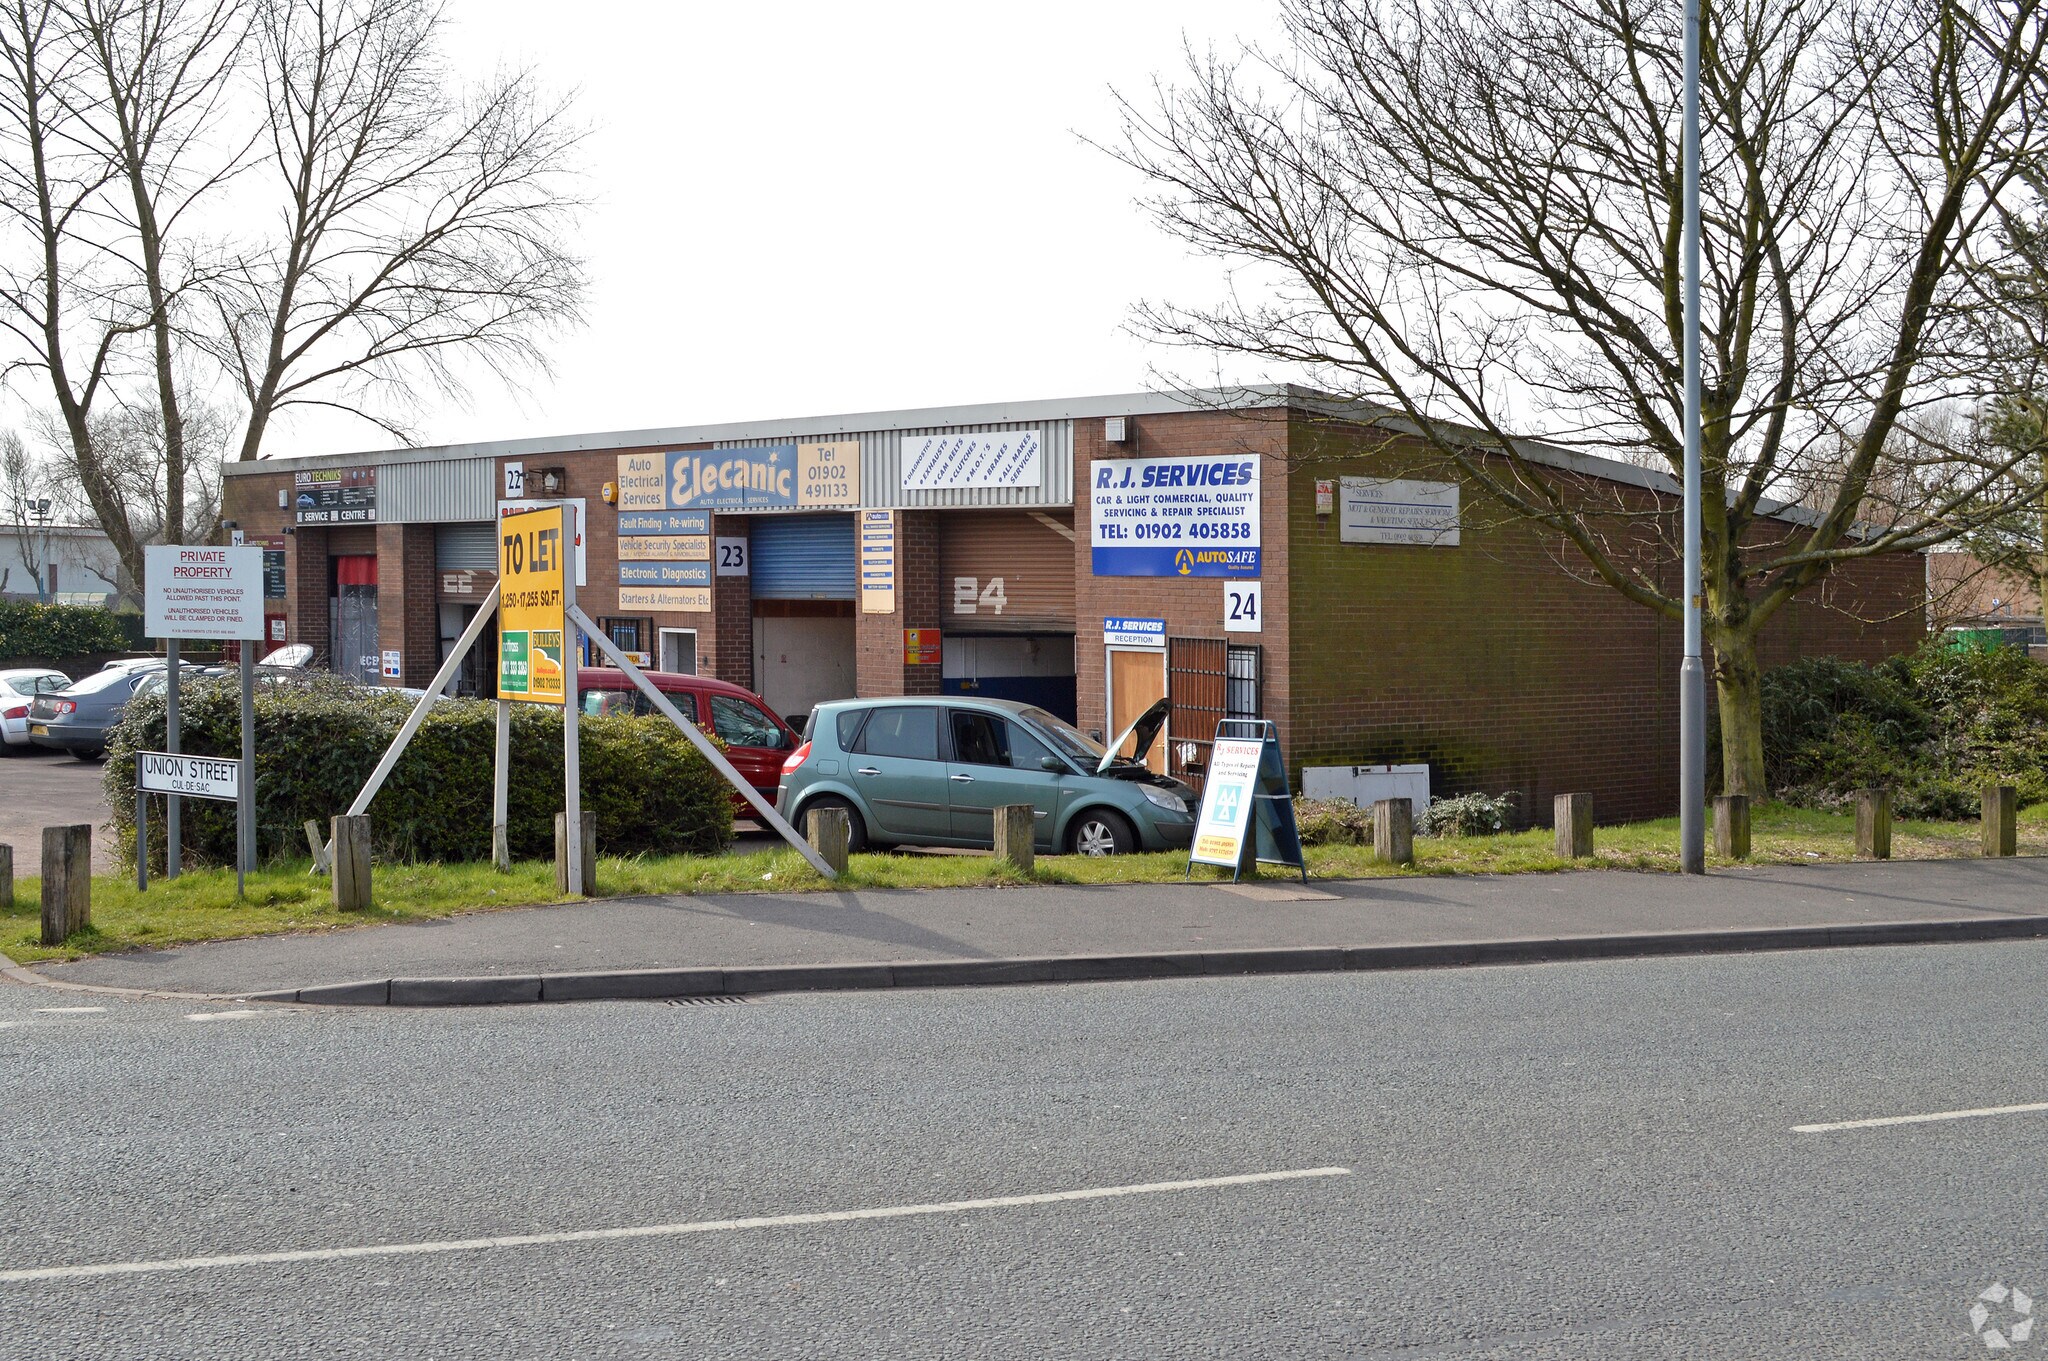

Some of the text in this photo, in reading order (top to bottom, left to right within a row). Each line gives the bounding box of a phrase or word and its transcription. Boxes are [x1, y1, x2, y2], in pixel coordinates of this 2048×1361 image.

[817, 447, 835, 462] Tel
[907, 439, 933, 480] DIAGNOSTICS
[922, 439, 948, 480] EXHAUSTS
[937, 438, 964, 480] CAM BELTS
[952, 441, 977, 479] CLUTCHES
[987, 443, 1008, 476] BRAKES
[1001, 433, 1031, 479] ALL MAKES
[628, 459, 651, 471] Auto
[1010, 441, 1038, 484] SERVICING
[295, 470, 341, 483] EURO TECHNIKS
[508, 470, 521, 490] 22
[671, 452, 791, 506] Elecanic
[808, 465, 846, 480] 01902
[1096, 462, 1254, 489] R.J. SERVICES
[620, 474, 663, 489] Electrical
[805, 483, 848, 498] 491133
[624, 492, 660, 505] Services
[747, 496, 769, 504] SERVICES
[1096, 492, 1254, 505] CAR & LIGHT COMMERCIAL, QUALITY
[304, 511, 328, 521] SERVICE
[341, 510, 366, 520] CENTRE
[1104, 506, 1245, 517] SERVICING & REPAIR SPECIALIST
[1369, 506, 1397, 515] GENERAL
[1399, 507, 1422, 516] REPAIRS
[620, 517, 705, 531] Fault Finding Re-wiring
[1100, 523, 1251, 539] TEL: 01902 405858
[504, 528, 559, 575] TO LET
[619, 540, 706, 553] Vehicle Security Specialists
[180, 551, 225, 562] PRIVATE
[721, 545, 744, 568] 23
[1196, 551, 1256, 564] AUTOSAFE
[174, 567, 233, 578] PROPERTY
[621, 567, 706, 582] Electronic Diagnostics
[621, 593, 709, 605] Starters & Alternators Etc
[1230, 592, 1256, 620] 24
[1106, 620, 1163, 632] R.J. SERVICES
[533, 633, 560, 648] BULLEYS
[1114, 635, 1153, 643] RECEPTION
[1226, 746, 1259, 756] SERVICES
[145, 757, 236, 782] UNION STREET
